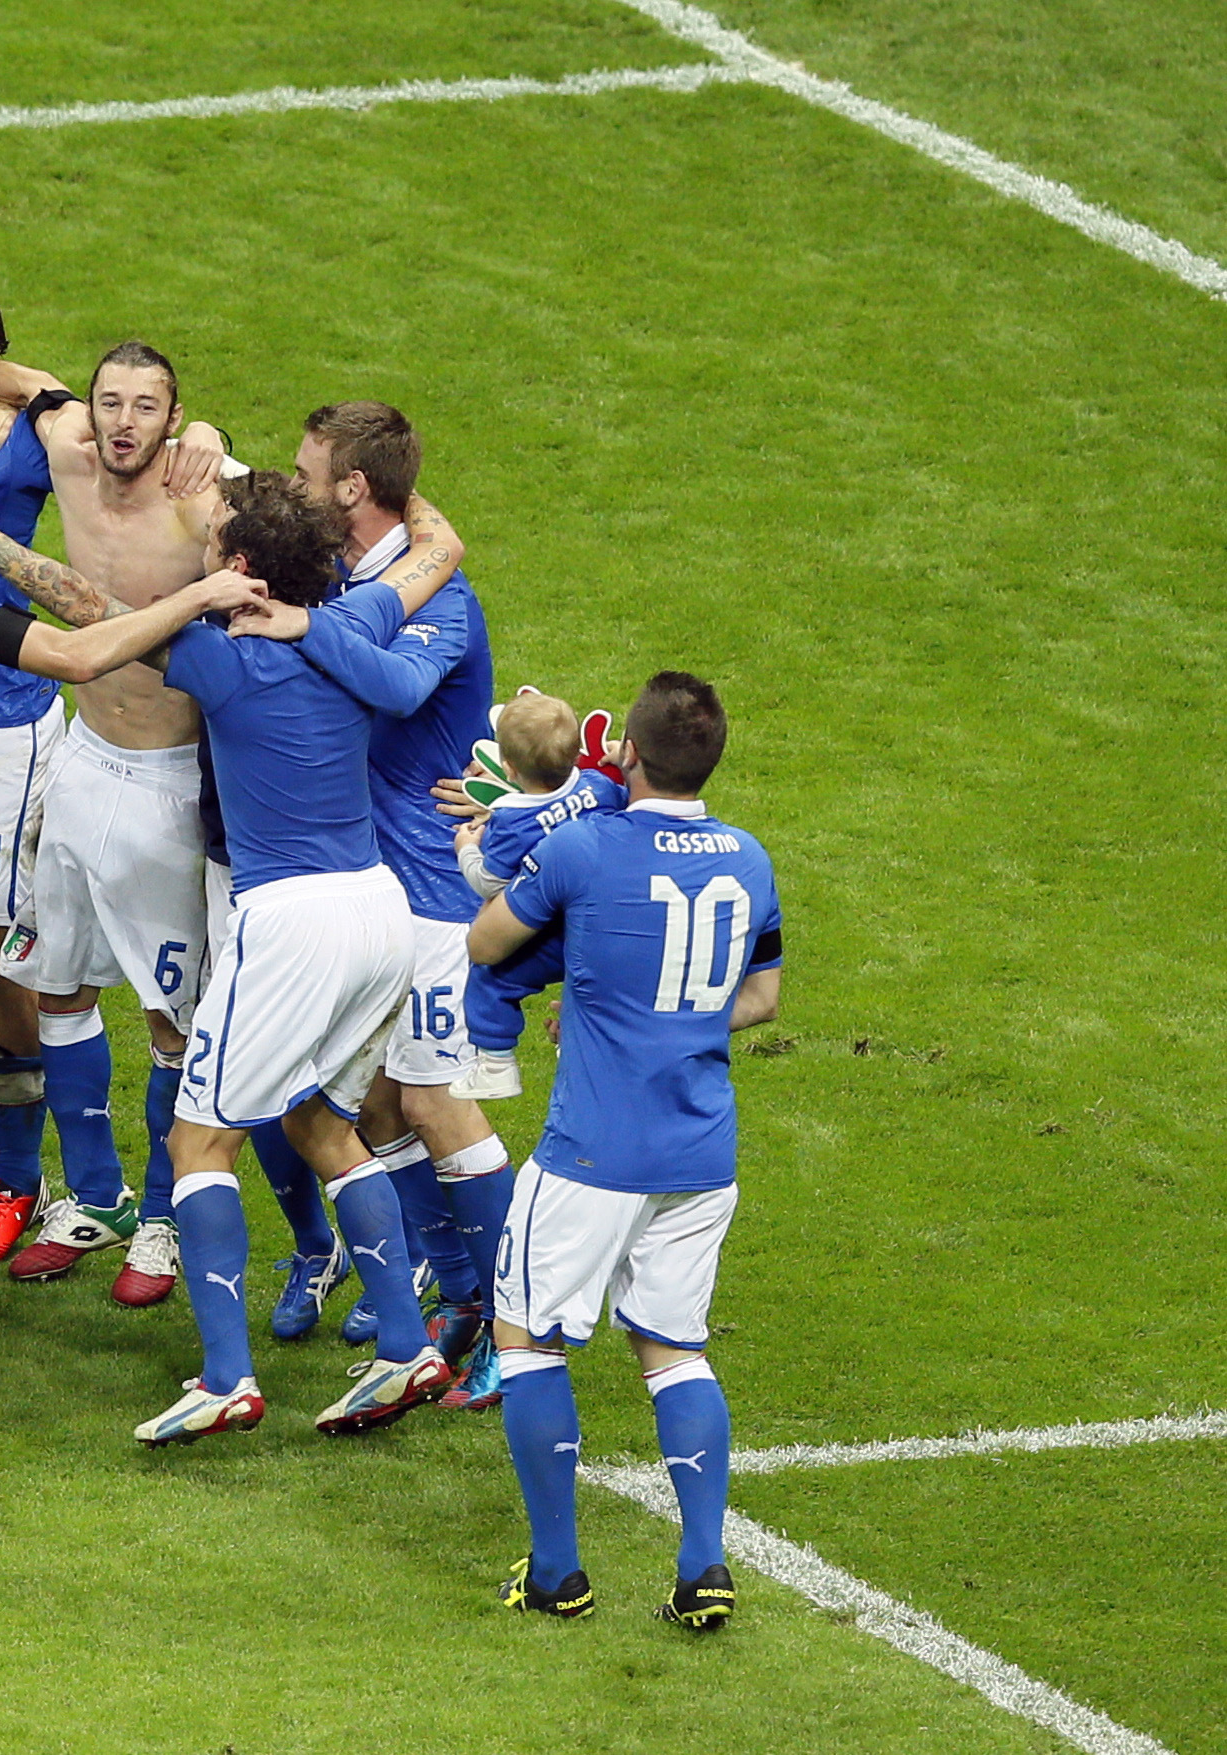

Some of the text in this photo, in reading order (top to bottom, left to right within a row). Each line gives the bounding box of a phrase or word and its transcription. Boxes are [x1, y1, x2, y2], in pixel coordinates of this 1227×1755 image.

[100, 759, 133, 778] ITALA
[654, 828, 741, 855] cassano
[154, 940, 187, 996] 6
[649, 874, 752, 1013] 10
[410, 985, 455, 1040] 16
[186, 1028, 214, 1087] 2
